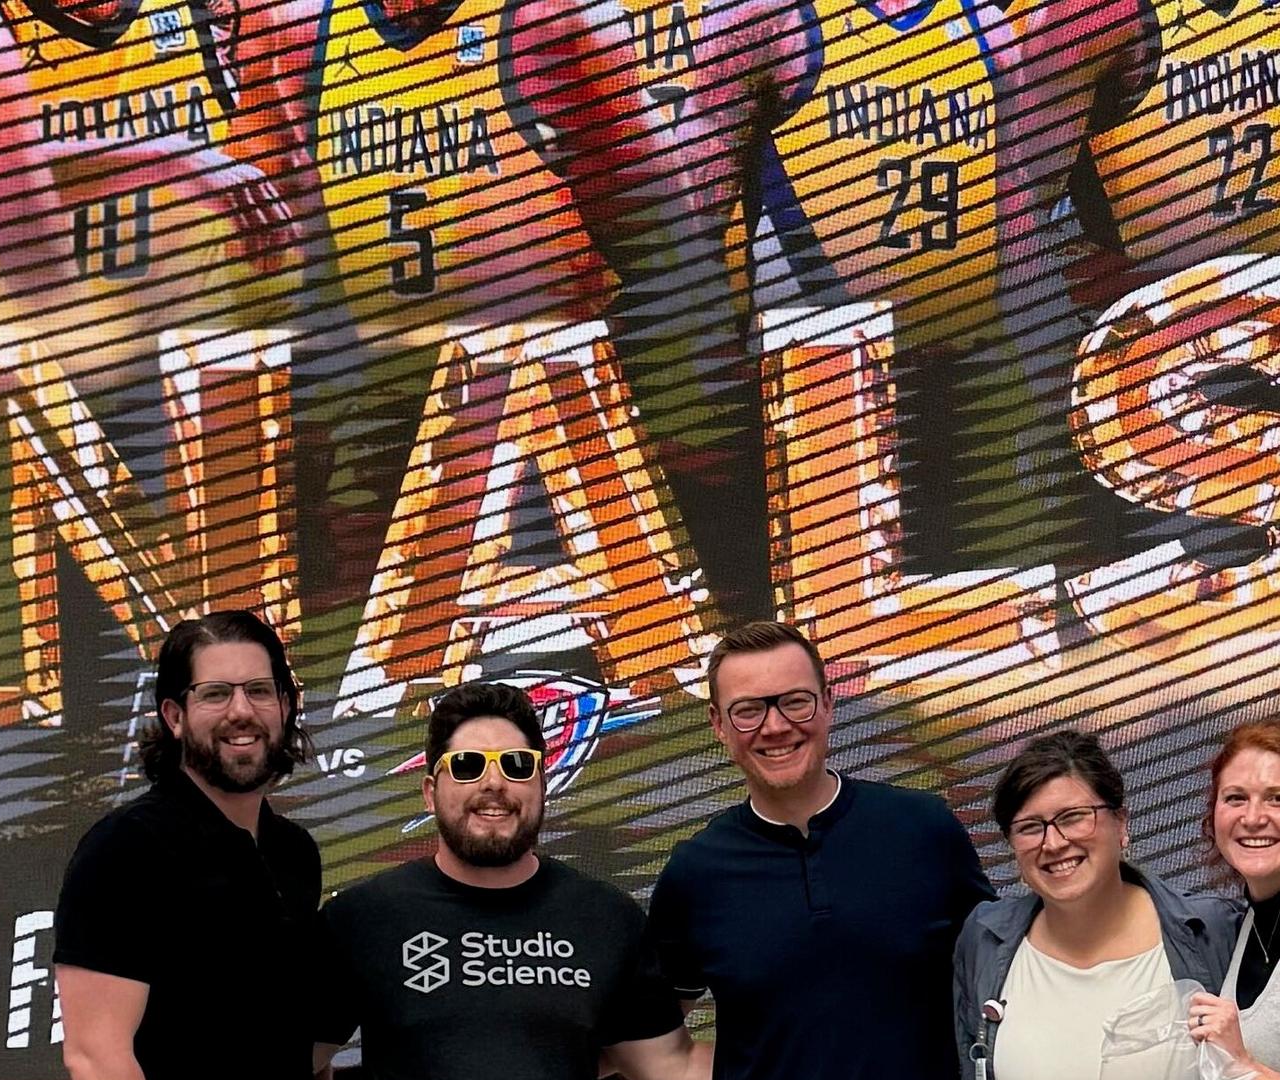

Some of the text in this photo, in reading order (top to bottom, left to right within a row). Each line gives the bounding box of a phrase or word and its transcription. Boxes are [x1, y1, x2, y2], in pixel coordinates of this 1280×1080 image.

[331, 106, 499, 175] INDIANA
[827, 84, 991, 150] INDIANA
[878, 158, 958, 249] 29
[1209, 123, 1274, 218] 22
[389, 190, 435, 295] 5
[461, 931, 574, 958] Studio
[462, 959, 591, 988] Science
